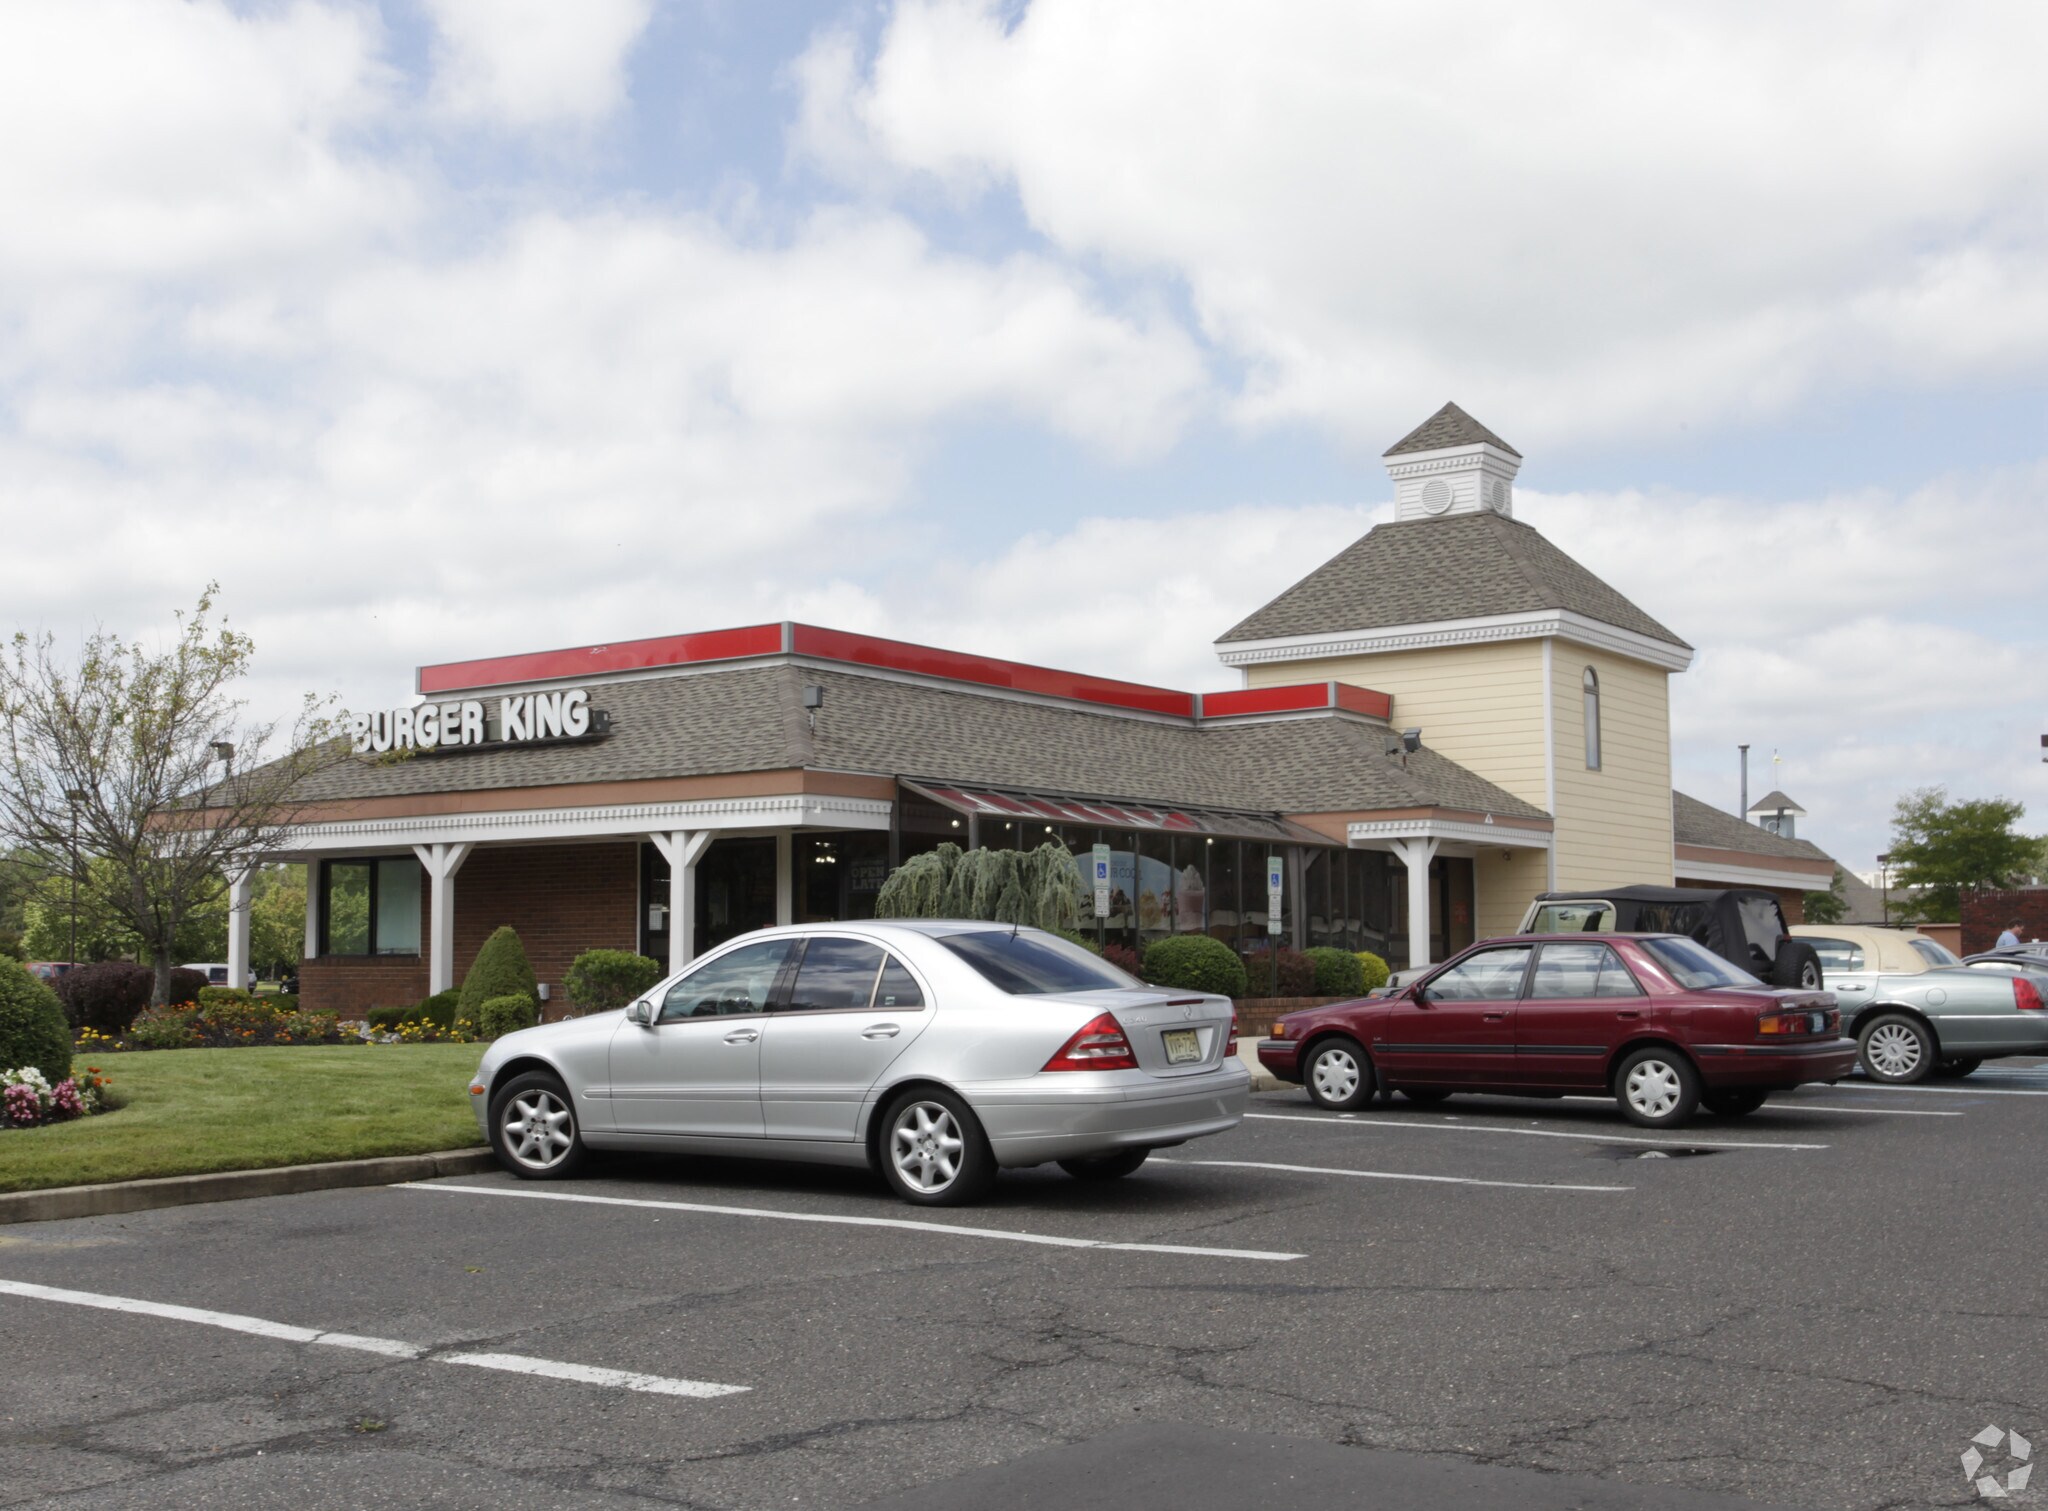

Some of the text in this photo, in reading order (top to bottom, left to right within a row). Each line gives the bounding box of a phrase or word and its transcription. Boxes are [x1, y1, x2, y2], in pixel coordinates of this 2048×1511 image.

[352, 689, 590, 752] BURGER KING
[851, 866, 885, 878] OPEN
